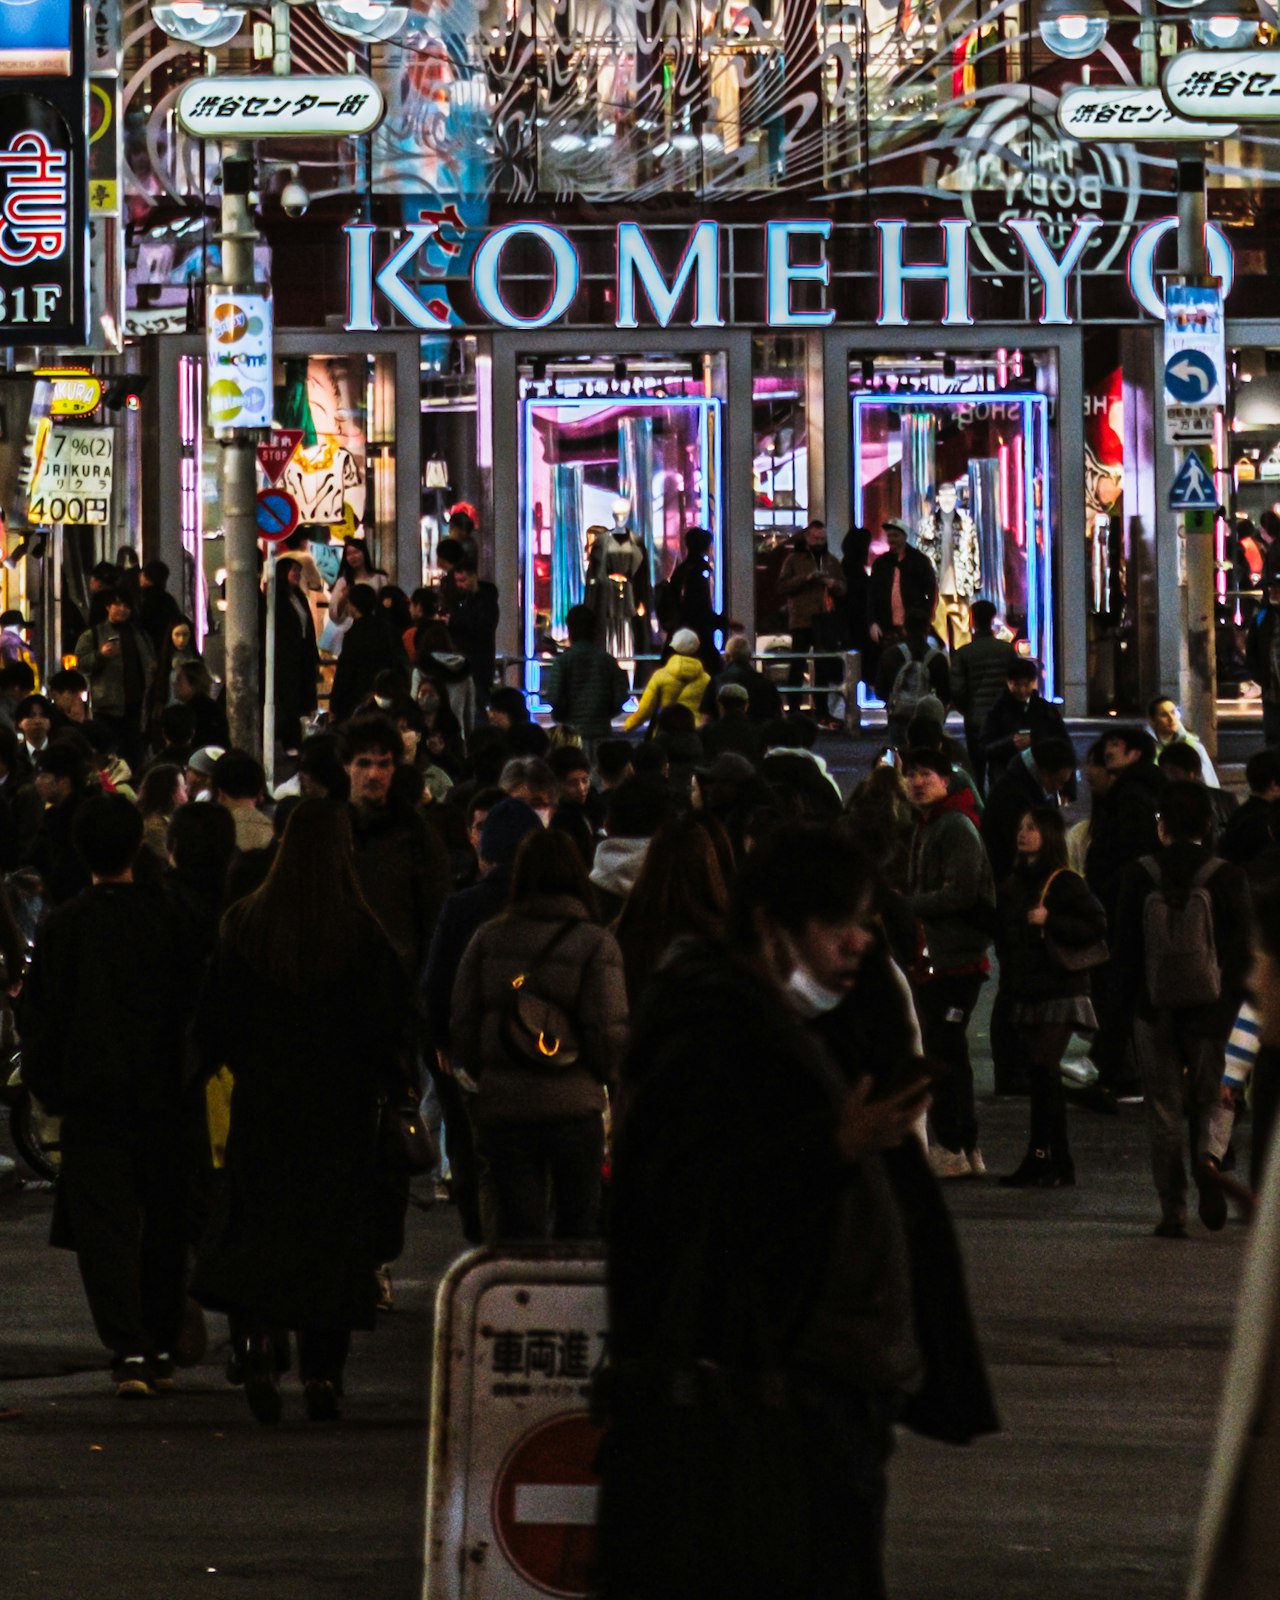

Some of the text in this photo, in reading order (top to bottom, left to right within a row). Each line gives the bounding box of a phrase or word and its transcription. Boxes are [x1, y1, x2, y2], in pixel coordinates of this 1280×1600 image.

[38, 60, 65, 70] SPACE
[188, 93, 370, 118] 渋谷センター街
[342, 217, 1237, 331] KOMEHYO
[208, 350, 268, 368] Welcome
[261, 450, 288, 461] STOP
[29, 497, 108, 523] 400円
